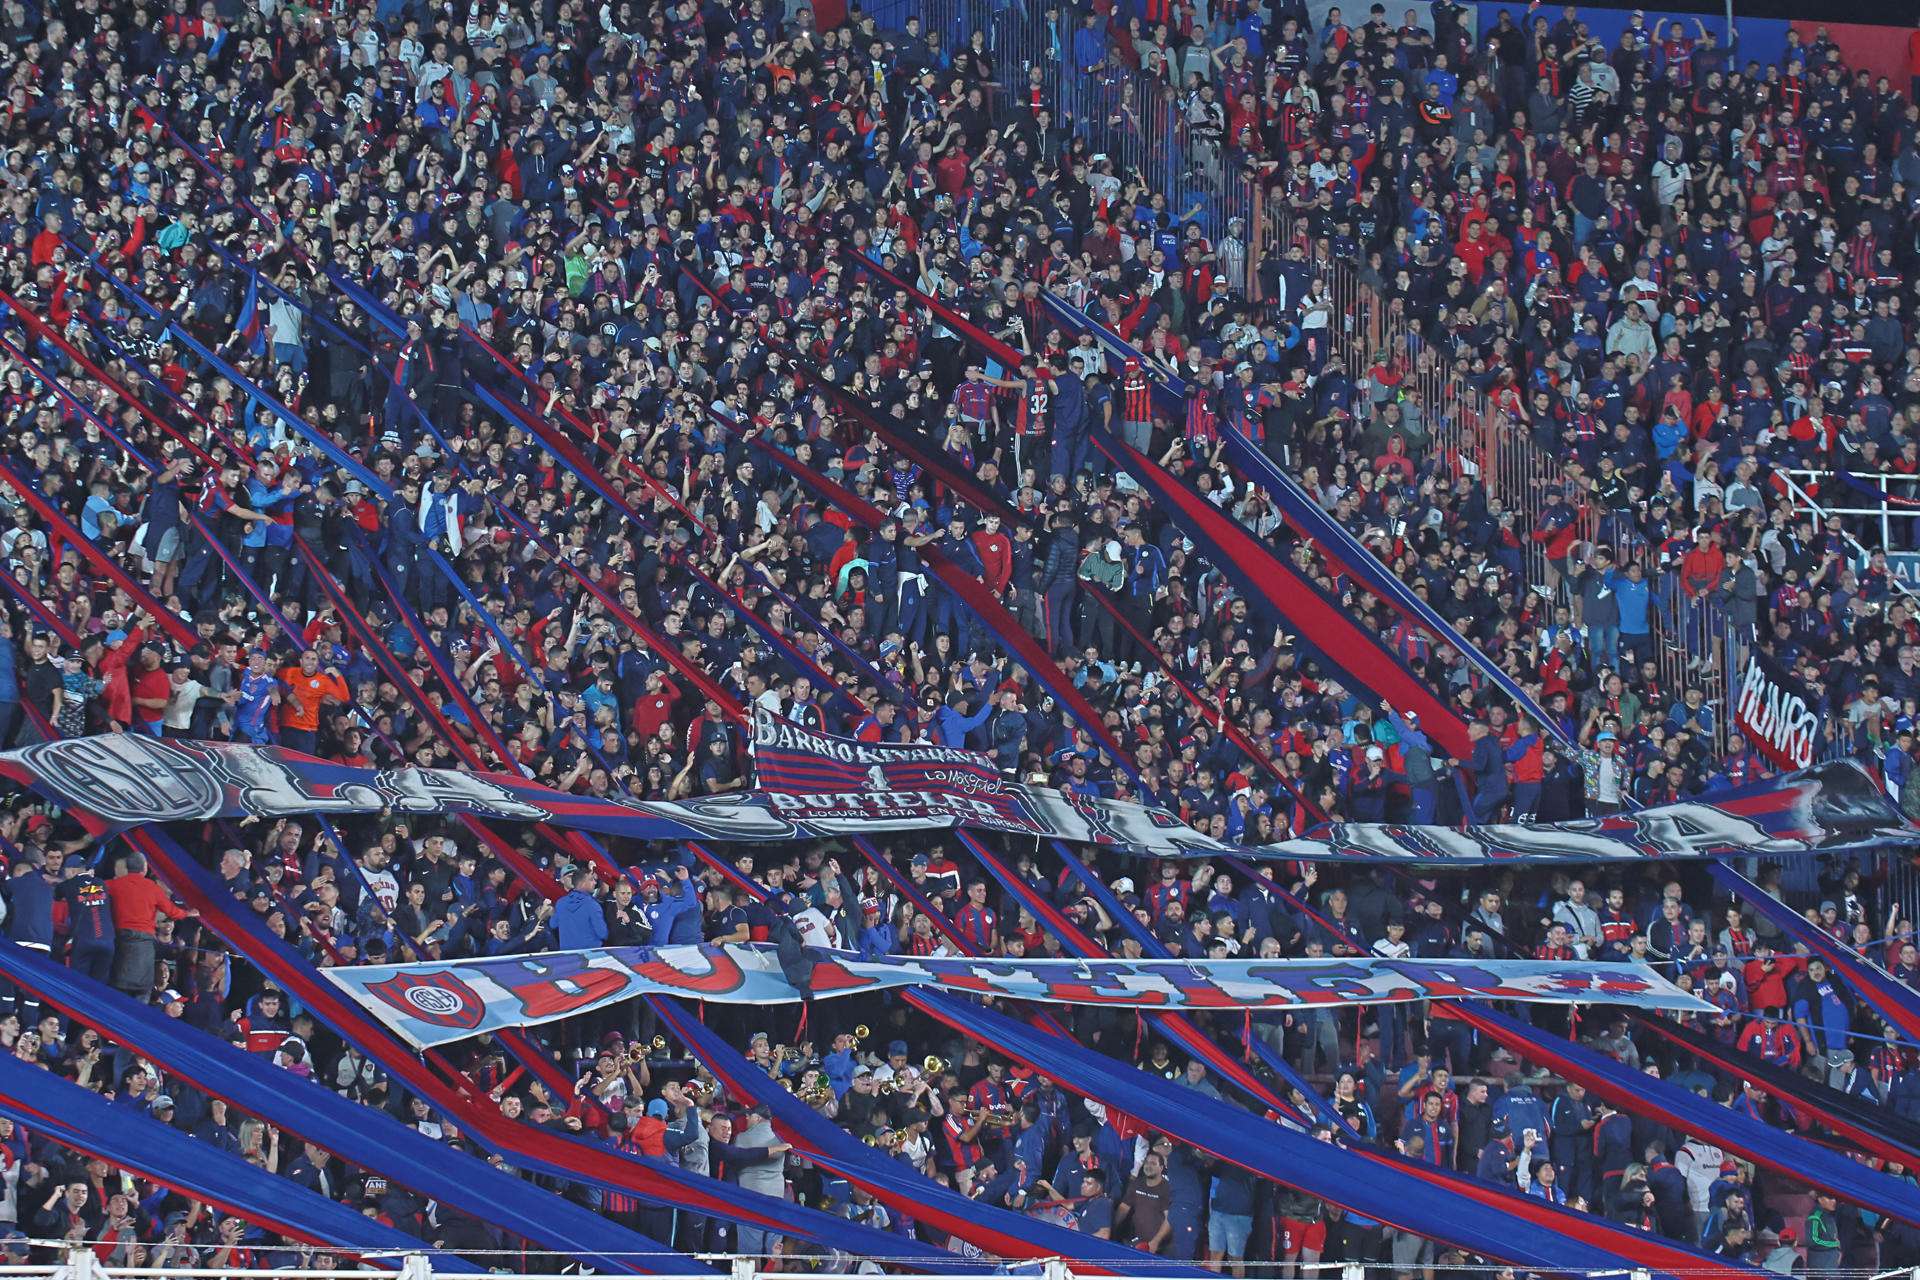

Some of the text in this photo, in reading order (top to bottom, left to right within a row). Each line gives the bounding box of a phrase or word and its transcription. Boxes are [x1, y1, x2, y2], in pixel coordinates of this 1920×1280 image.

[1030, 394, 1048, 414] 32
[1738, 656, 1818, 769] MUNRO
[755, 707, 855, 763] BARRIO
[963, 773, 1005, 795] Fiel
[769, 791, 1004, 819] BUTTELER
[808, 810, 870, 818] LOCURA
[880, 808, 916, 817] ESTA
[927, 808, 950, 816] EN
[955, 810, 975, 820] EL
[979, 814, 1028, 831] BARRIO
